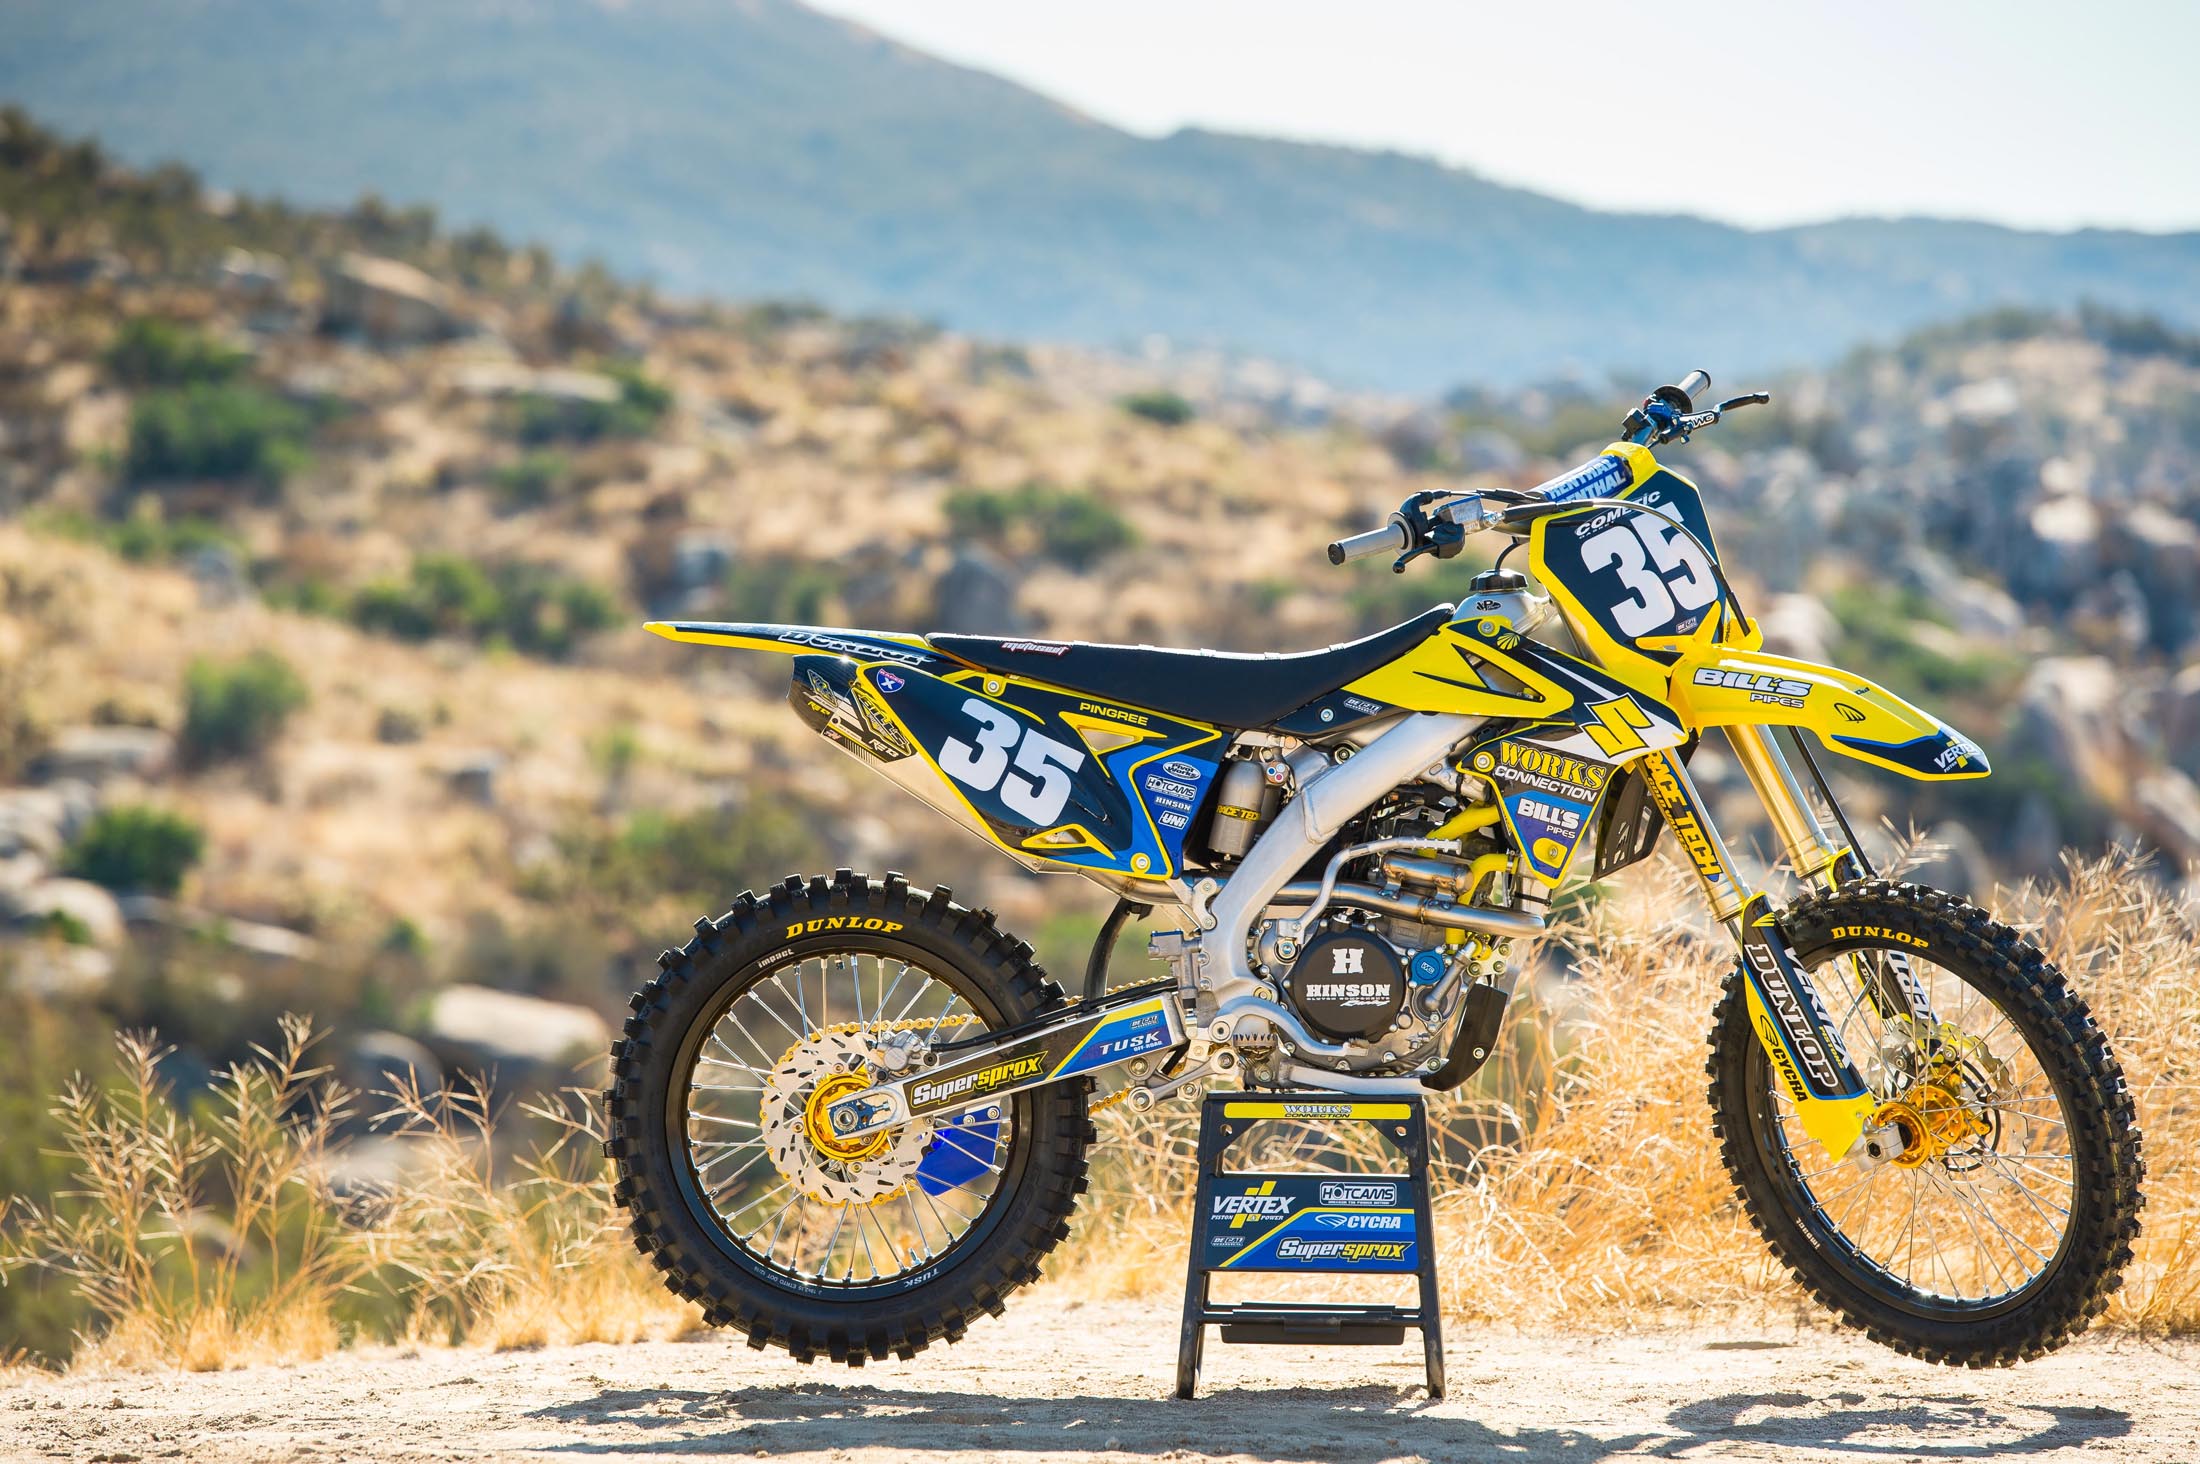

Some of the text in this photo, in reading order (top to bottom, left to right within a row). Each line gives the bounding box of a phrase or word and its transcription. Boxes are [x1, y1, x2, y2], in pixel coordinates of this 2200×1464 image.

[1560, 470, 1626, 503] ENTHAL
[1575, 491, 1661, 537] COMETIC
[1581, 502, 1718, 637] 35
[1693, 667, 1813, 697] BILL'S
[1750, 693, 1805, 708] PIPES
[1079, 702, 1149, 726] PINGREE
[939, 699, 1085, 826] 35
[1500, 741, 1607, 789] WORKS
[1147, 778, 1195, 797] HOTCAMS
[1494, 765, 1597, 802] CONNECTION
[1155, 796, 1191, 812] HINSON
[1517, 798, 1580, 829] BILL'S
[1643, 750, 1724, 876] RACE TECH
[1162, 812, 1187, 828] UNI
[1546, 825, 1576, 839] PIPES
[785, 916, 904, 939] DUNLOP
[1831, 926, 1929, 949] DUNLOP
[758, 948, 795, 969] impact
[1332, 948, 1364, 974] H
[1306, 984, 1391, 997] HINSON
[1744, 943, 1838, 1088] DUNLOP
[1100, 1031, 1160, 1055] TUSK
[1818, 1026, 1845, 1069] PISTONS
[913, 1055, 1042, 1106] Supersprox
[1772, 1048, 1809, 1102] CYCRA
[1283, 1105, 1352, 1113] WORKS
[1213, 1196, 1296, 1214] VERTEX
[1322, 1187, 1394, 1200] HOTCAMS
[1347, 1215, 1401, 1228] CYCRA
[1279, 1239, 1404, 1262] Supersprox
[904, 1268, 940, 1289] TUSK
